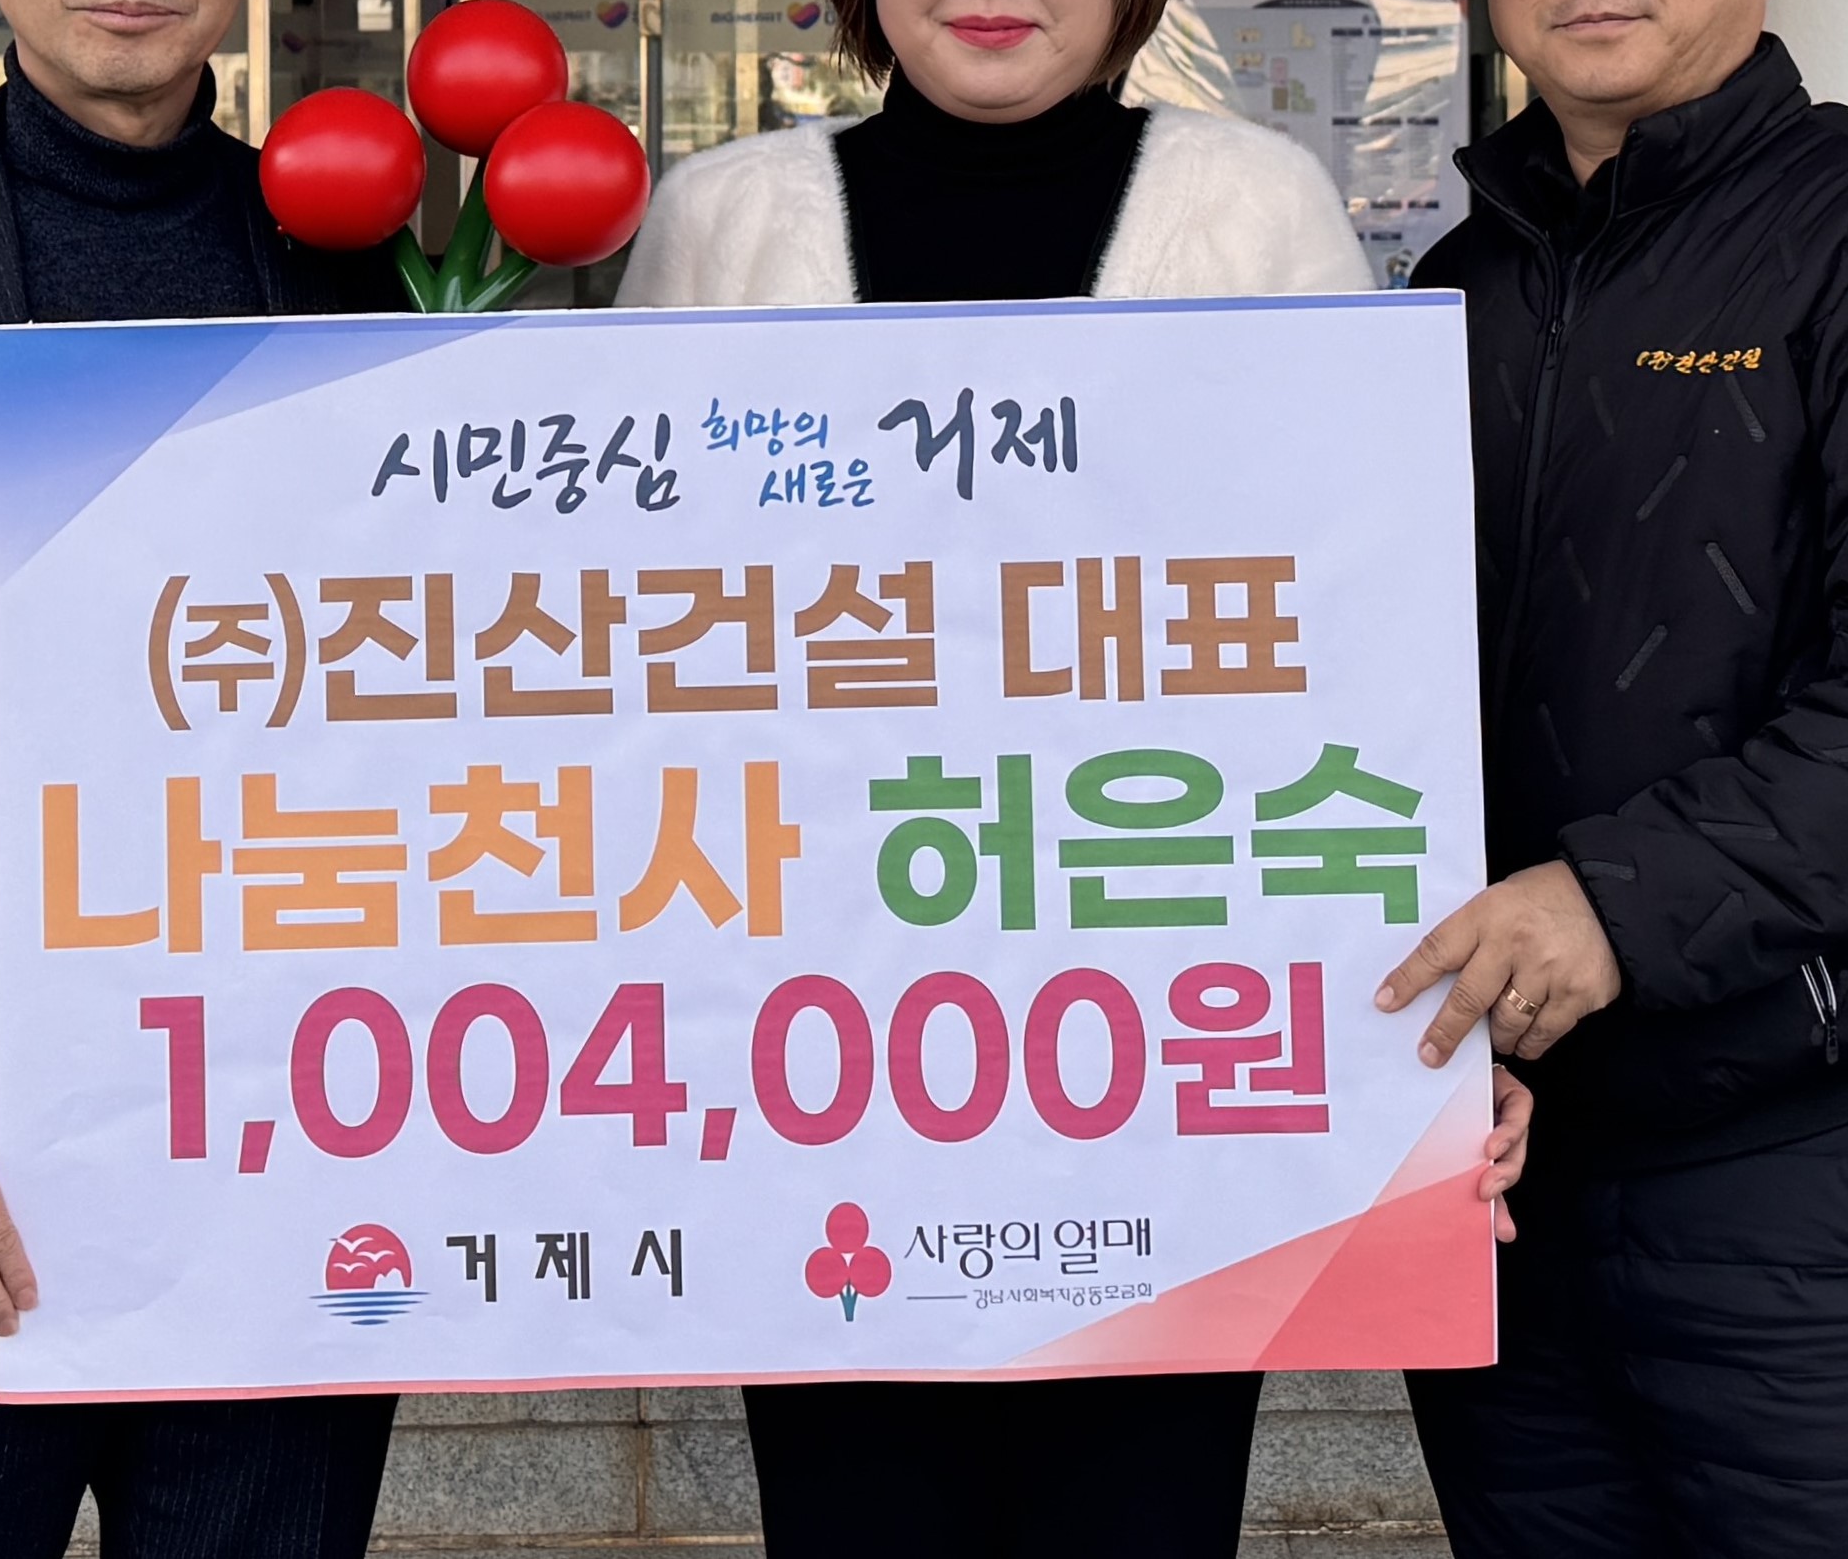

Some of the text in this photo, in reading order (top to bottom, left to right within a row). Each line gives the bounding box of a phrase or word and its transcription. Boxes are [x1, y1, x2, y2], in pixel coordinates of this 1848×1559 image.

[372, 388, 1078, 515] 시민중심 희망의 새로운 거제
[1001, 557, 1309, 702] 대표
[42, 743, 1428, 954] 나눔천사 허은숙
[139, 962, 1331, 1175] 1,004,000원
[446, 1218, 1153, 1303] 거제시 사랑의 열매
